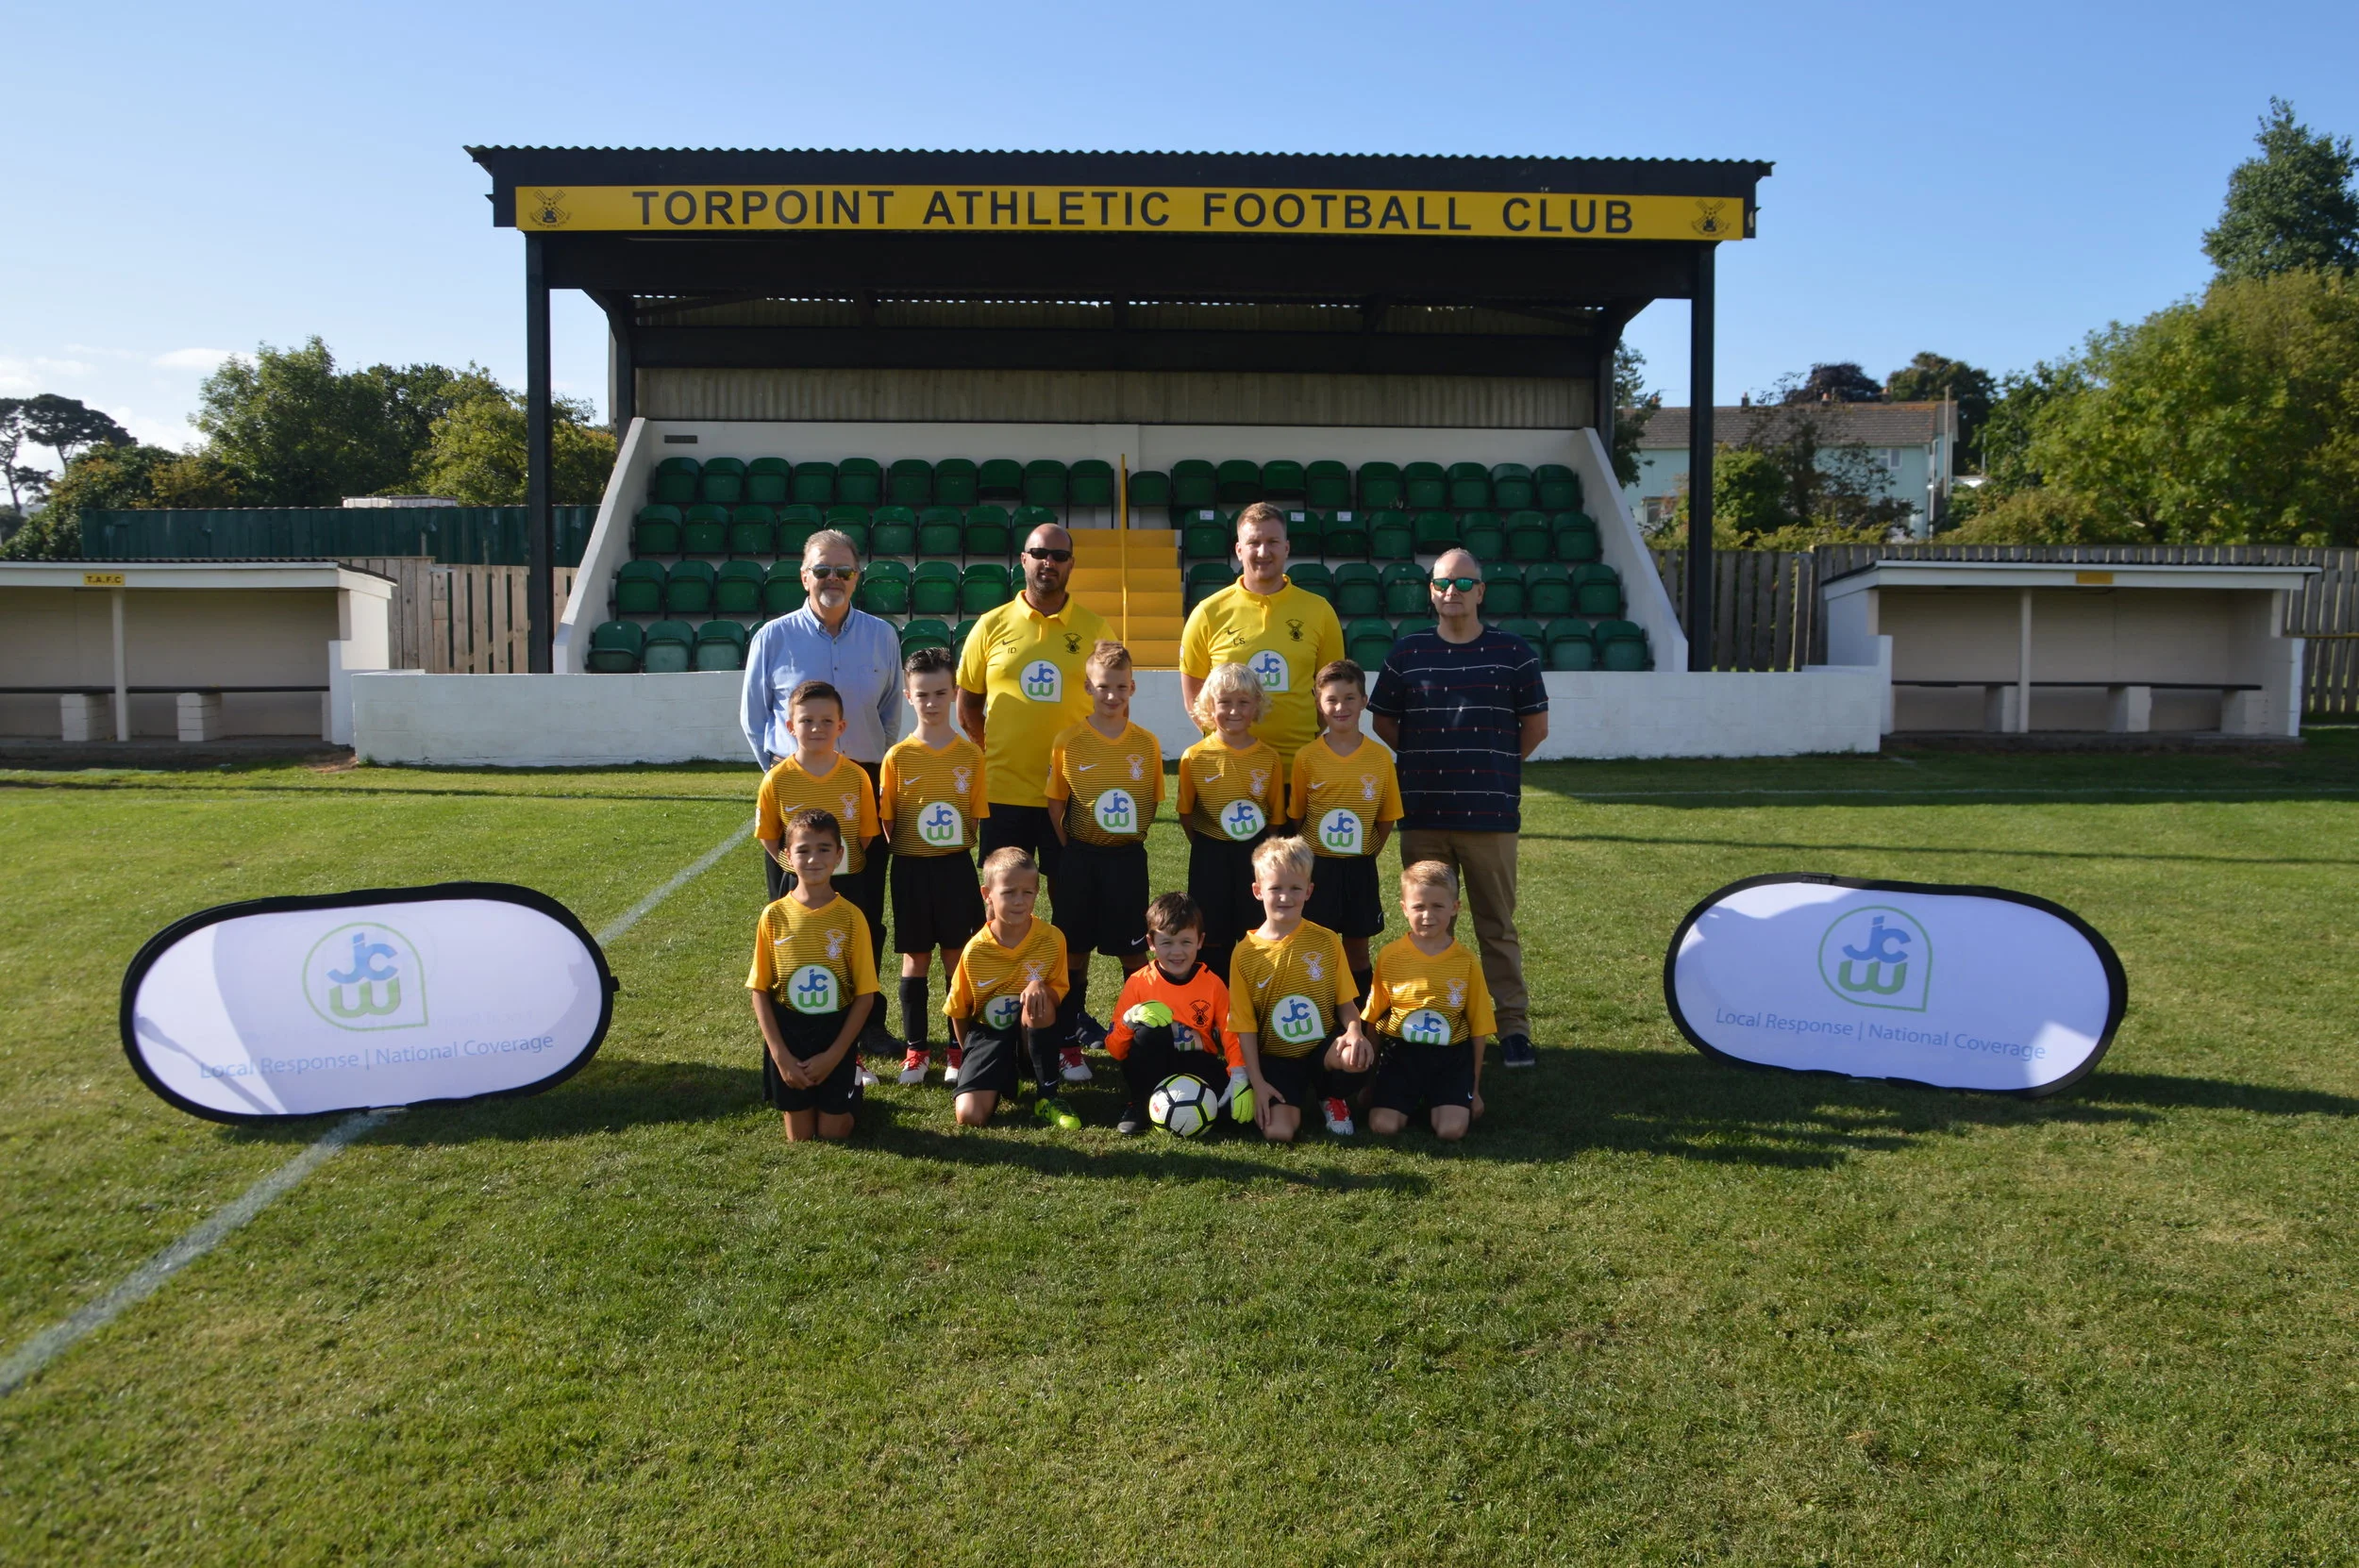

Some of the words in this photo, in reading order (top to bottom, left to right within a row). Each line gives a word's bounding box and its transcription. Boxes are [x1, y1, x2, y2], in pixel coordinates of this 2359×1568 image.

[632, 190, 895, 225] TORPOINT
[922, 191, 1170, 226] ATHLETIC
[1203, 192, 1472, 230] FOOTBALL
[1502, 197, 1633, 234] CLUB
[200, 1060, 254, 1078] Local
[259, 1053, 360, 1075] Response
[376, 1041, 459, 1065] National
[463, 1035, 554, 1055] Coverage
[1715, 1008, 1762, 1027] Local
[1765, 1013, 1853, 1036] Response
[1868, 1024, 1949, 1046] National
[1953, 1033, 2046, 1061] Coverage
